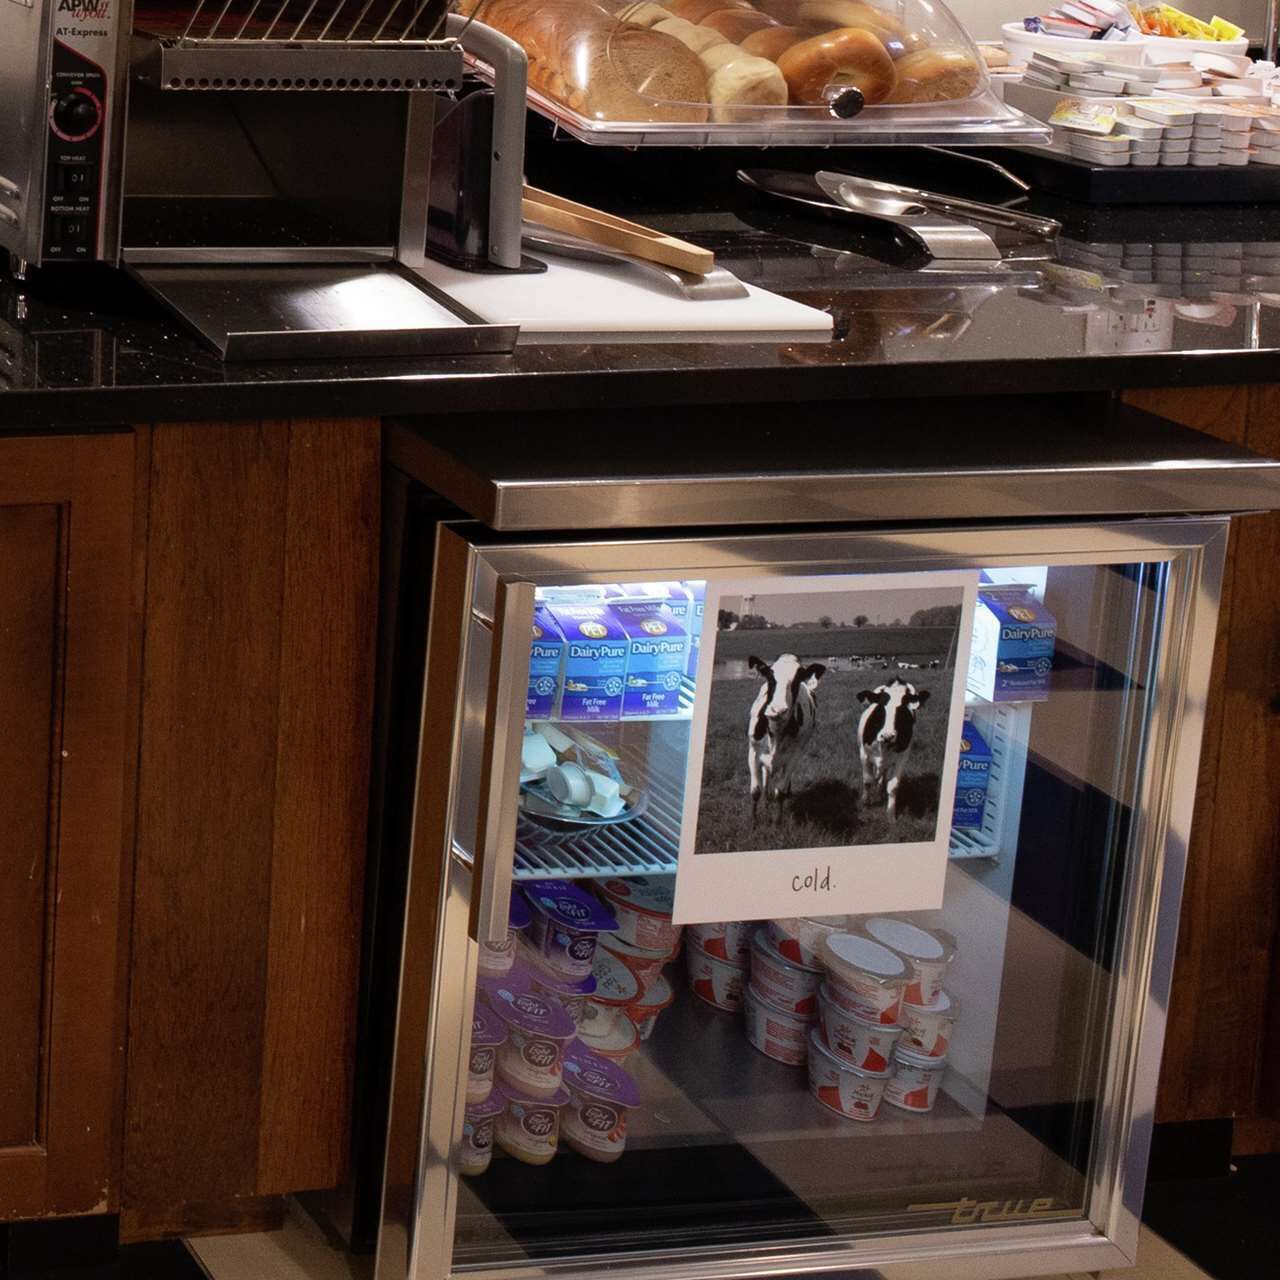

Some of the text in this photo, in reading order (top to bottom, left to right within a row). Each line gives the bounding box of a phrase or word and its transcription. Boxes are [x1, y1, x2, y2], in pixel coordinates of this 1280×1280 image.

[56, 27, 108, 38] AT-Express
[571, 646, 625, 661] DairyPure
[632, 641, 684, 656] DairyPure
[791, 865, 837, 892] cold.
[951, 1196, 1056, 1225] true
